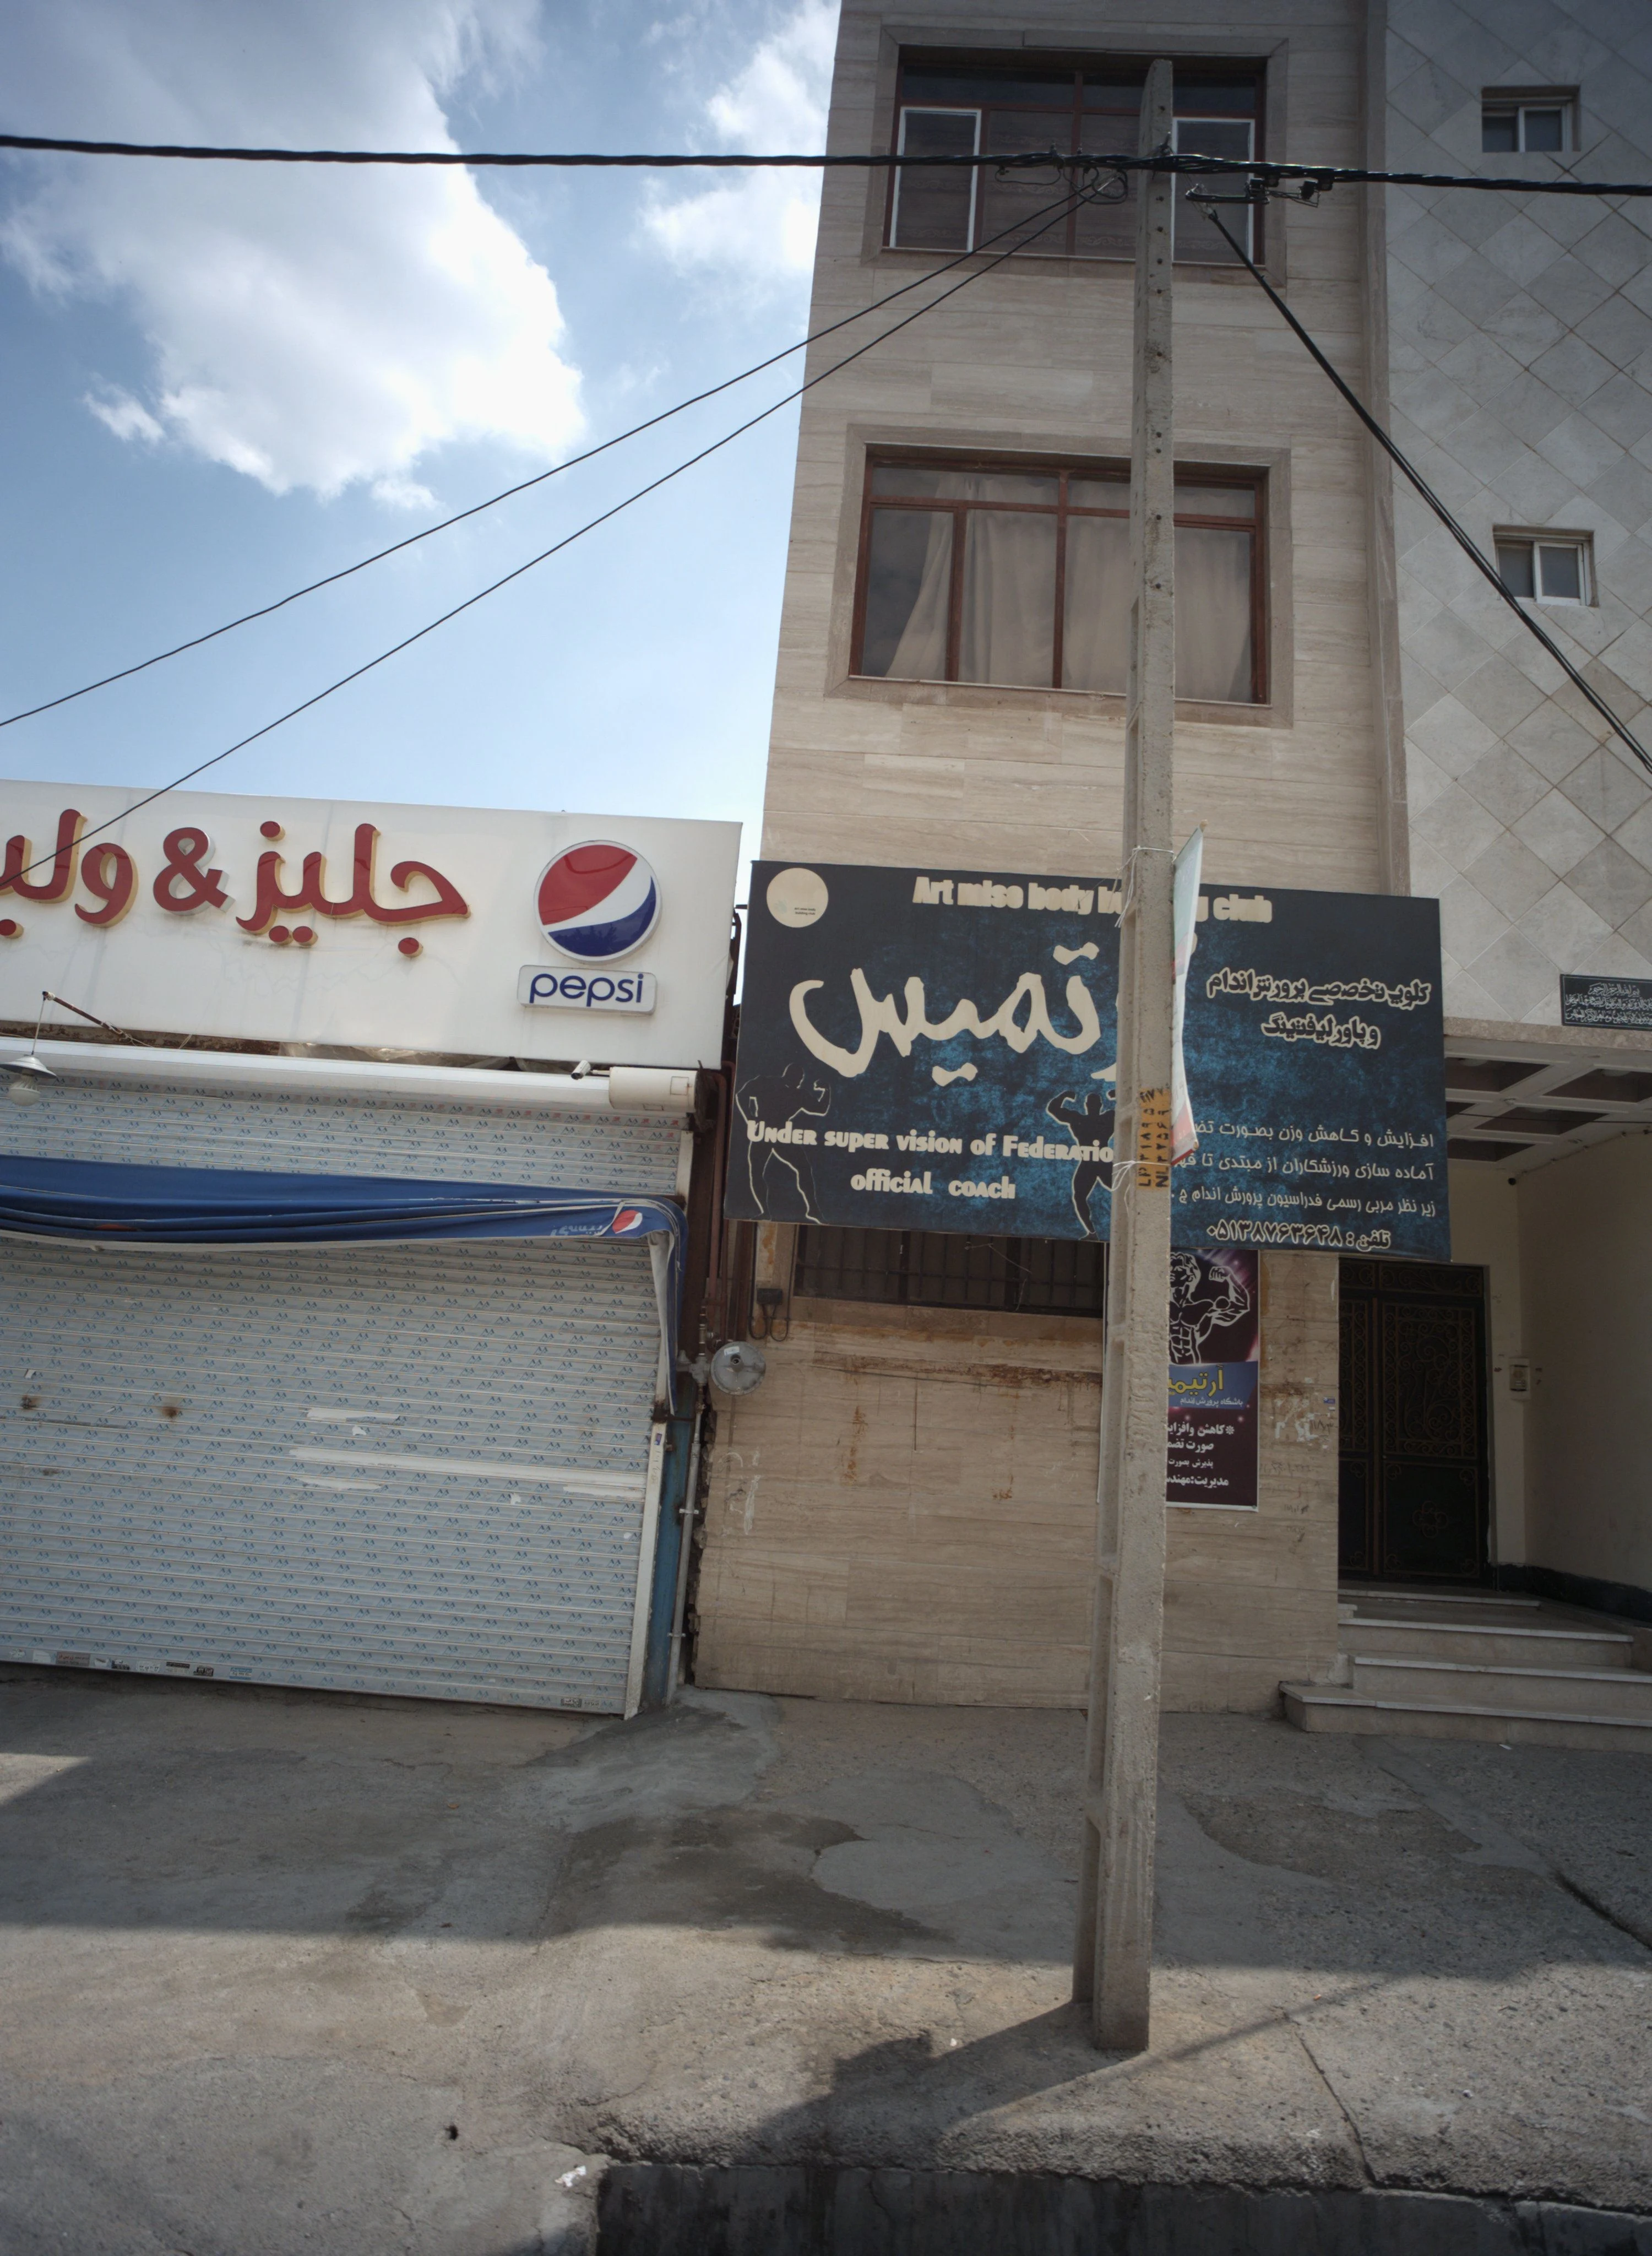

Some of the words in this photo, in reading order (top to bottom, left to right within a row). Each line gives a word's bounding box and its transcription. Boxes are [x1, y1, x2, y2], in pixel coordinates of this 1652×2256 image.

[153, 826, 236, 916] &
[235, 821, 471, 958] جلیز
[912, 876, 954, 905] Art
[1028, 882, 1094, 915] body
[529, 973, 644, 1007] pepsi
[1206, 967, 1255, 999] اندام
[1250, 974, 1309, 1002] پرورش
[1308, 978, 1387, 1006] تخصصی
[1387, 979, 1431, 1010] کلوپ
[1219, 1124, 1274, 1141] بصورت
[1279, 1126, 1303, 1142] وزن
[1308, 1126, 1359, 1142] کاهش
[1364, 1133, 1372, 1146] و
[1377, 1129, 1434, 1149] افزایش
[971, 1133, 996, 1156] of
[1202, 1153, 1214, 1167] تا
[1219, 1155, 1262, 1172] مبتدی
[1267, 1156, 1277, 1173] از
[1282, 1158, 1350, 1178] ورزشکاران
[1355, 1163, 1390, 1179] سازی
[1395, 1163, 1434, 1180] آماده
[1192, 1186, 1221, 1202] اندام
[1225, 1186, 1263, 1208] پرورش
[1267, 1192, 1323, 1209] فدراسیون
[1326, 1198, 1361, 1212] رسمی
[1366, 1200, 1394, 1213] مربی
[1398, 1198, 1417, 1214] نظر
[1421, 1201, 1436, 1217] زیر
[1180, 1397, 1195, 1406] اندام
[1196, 1396, 1219, 1408] پرورش
[1220, 1397, 1243, 1406] باشگاه
[1186, 1440, 1214, 1453] صورت
[1168, 1458, 1189, 1467] بصورت
[1192, 1458, 1213, 1469] پذیرش
